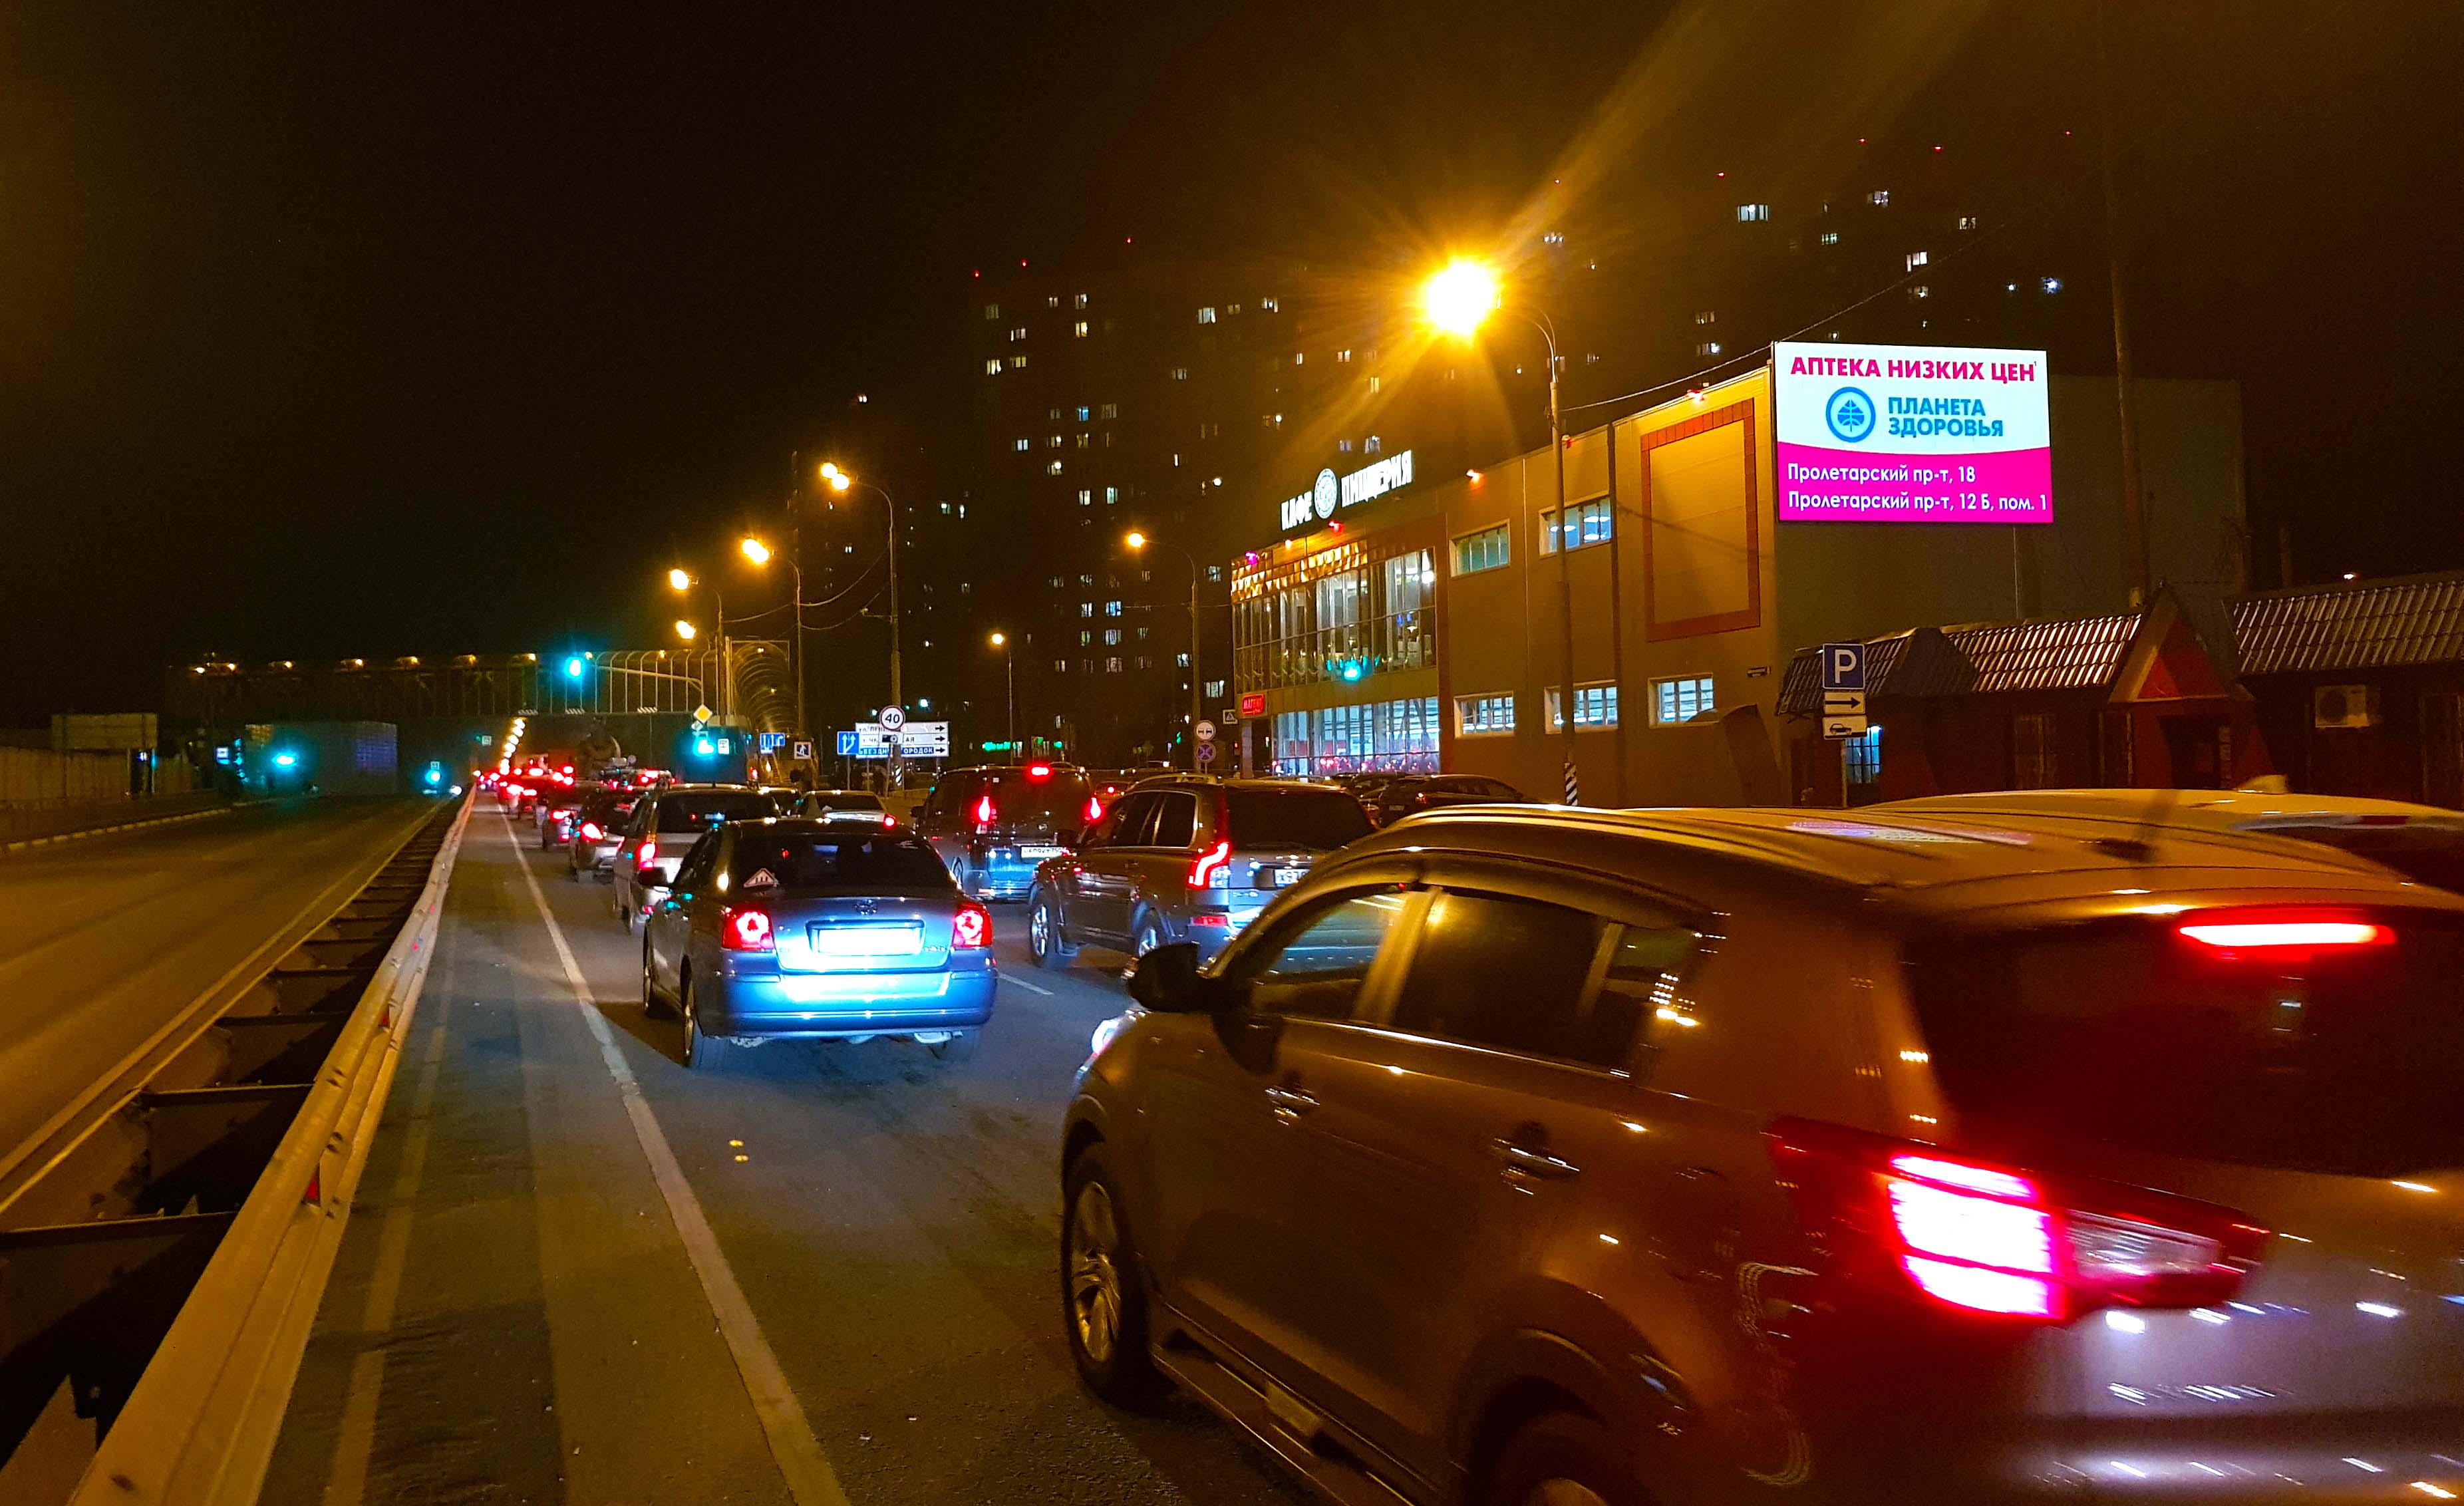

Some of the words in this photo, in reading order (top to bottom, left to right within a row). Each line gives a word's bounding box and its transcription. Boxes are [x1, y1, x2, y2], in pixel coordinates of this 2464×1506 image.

[1791, 357, 1881, 377] АПТЕКА
[1888, 360, 1985, 380] НИЗКИХ
[1991, 363, 2034, 384] ЦЕН
[1889, 397, 1986, 416] ПЛАНЕТА
[1889, 417, 2004, 438] ЗДОРОВЬЯ
[1788, 463, 1909, 485] Пролетарский
[1913, 469, 1953, 485] пр-т,
[1958, 466, 1976, 482] 18
[1281, 491, 1312, 531] КАФЕ
[1341, 450, 1412, 508] ПИЦЦЕРИЯ
[1789, 490, 1909, 512] Пролетарский
[1914, 496, 1954, 512] пр-т,
[1959, 493, 1976, 510] 12
[1999, 498, 2035, 510] пом.
[2040, 494, 2046, 510] 1
[885, 714, 900, 724] 40
